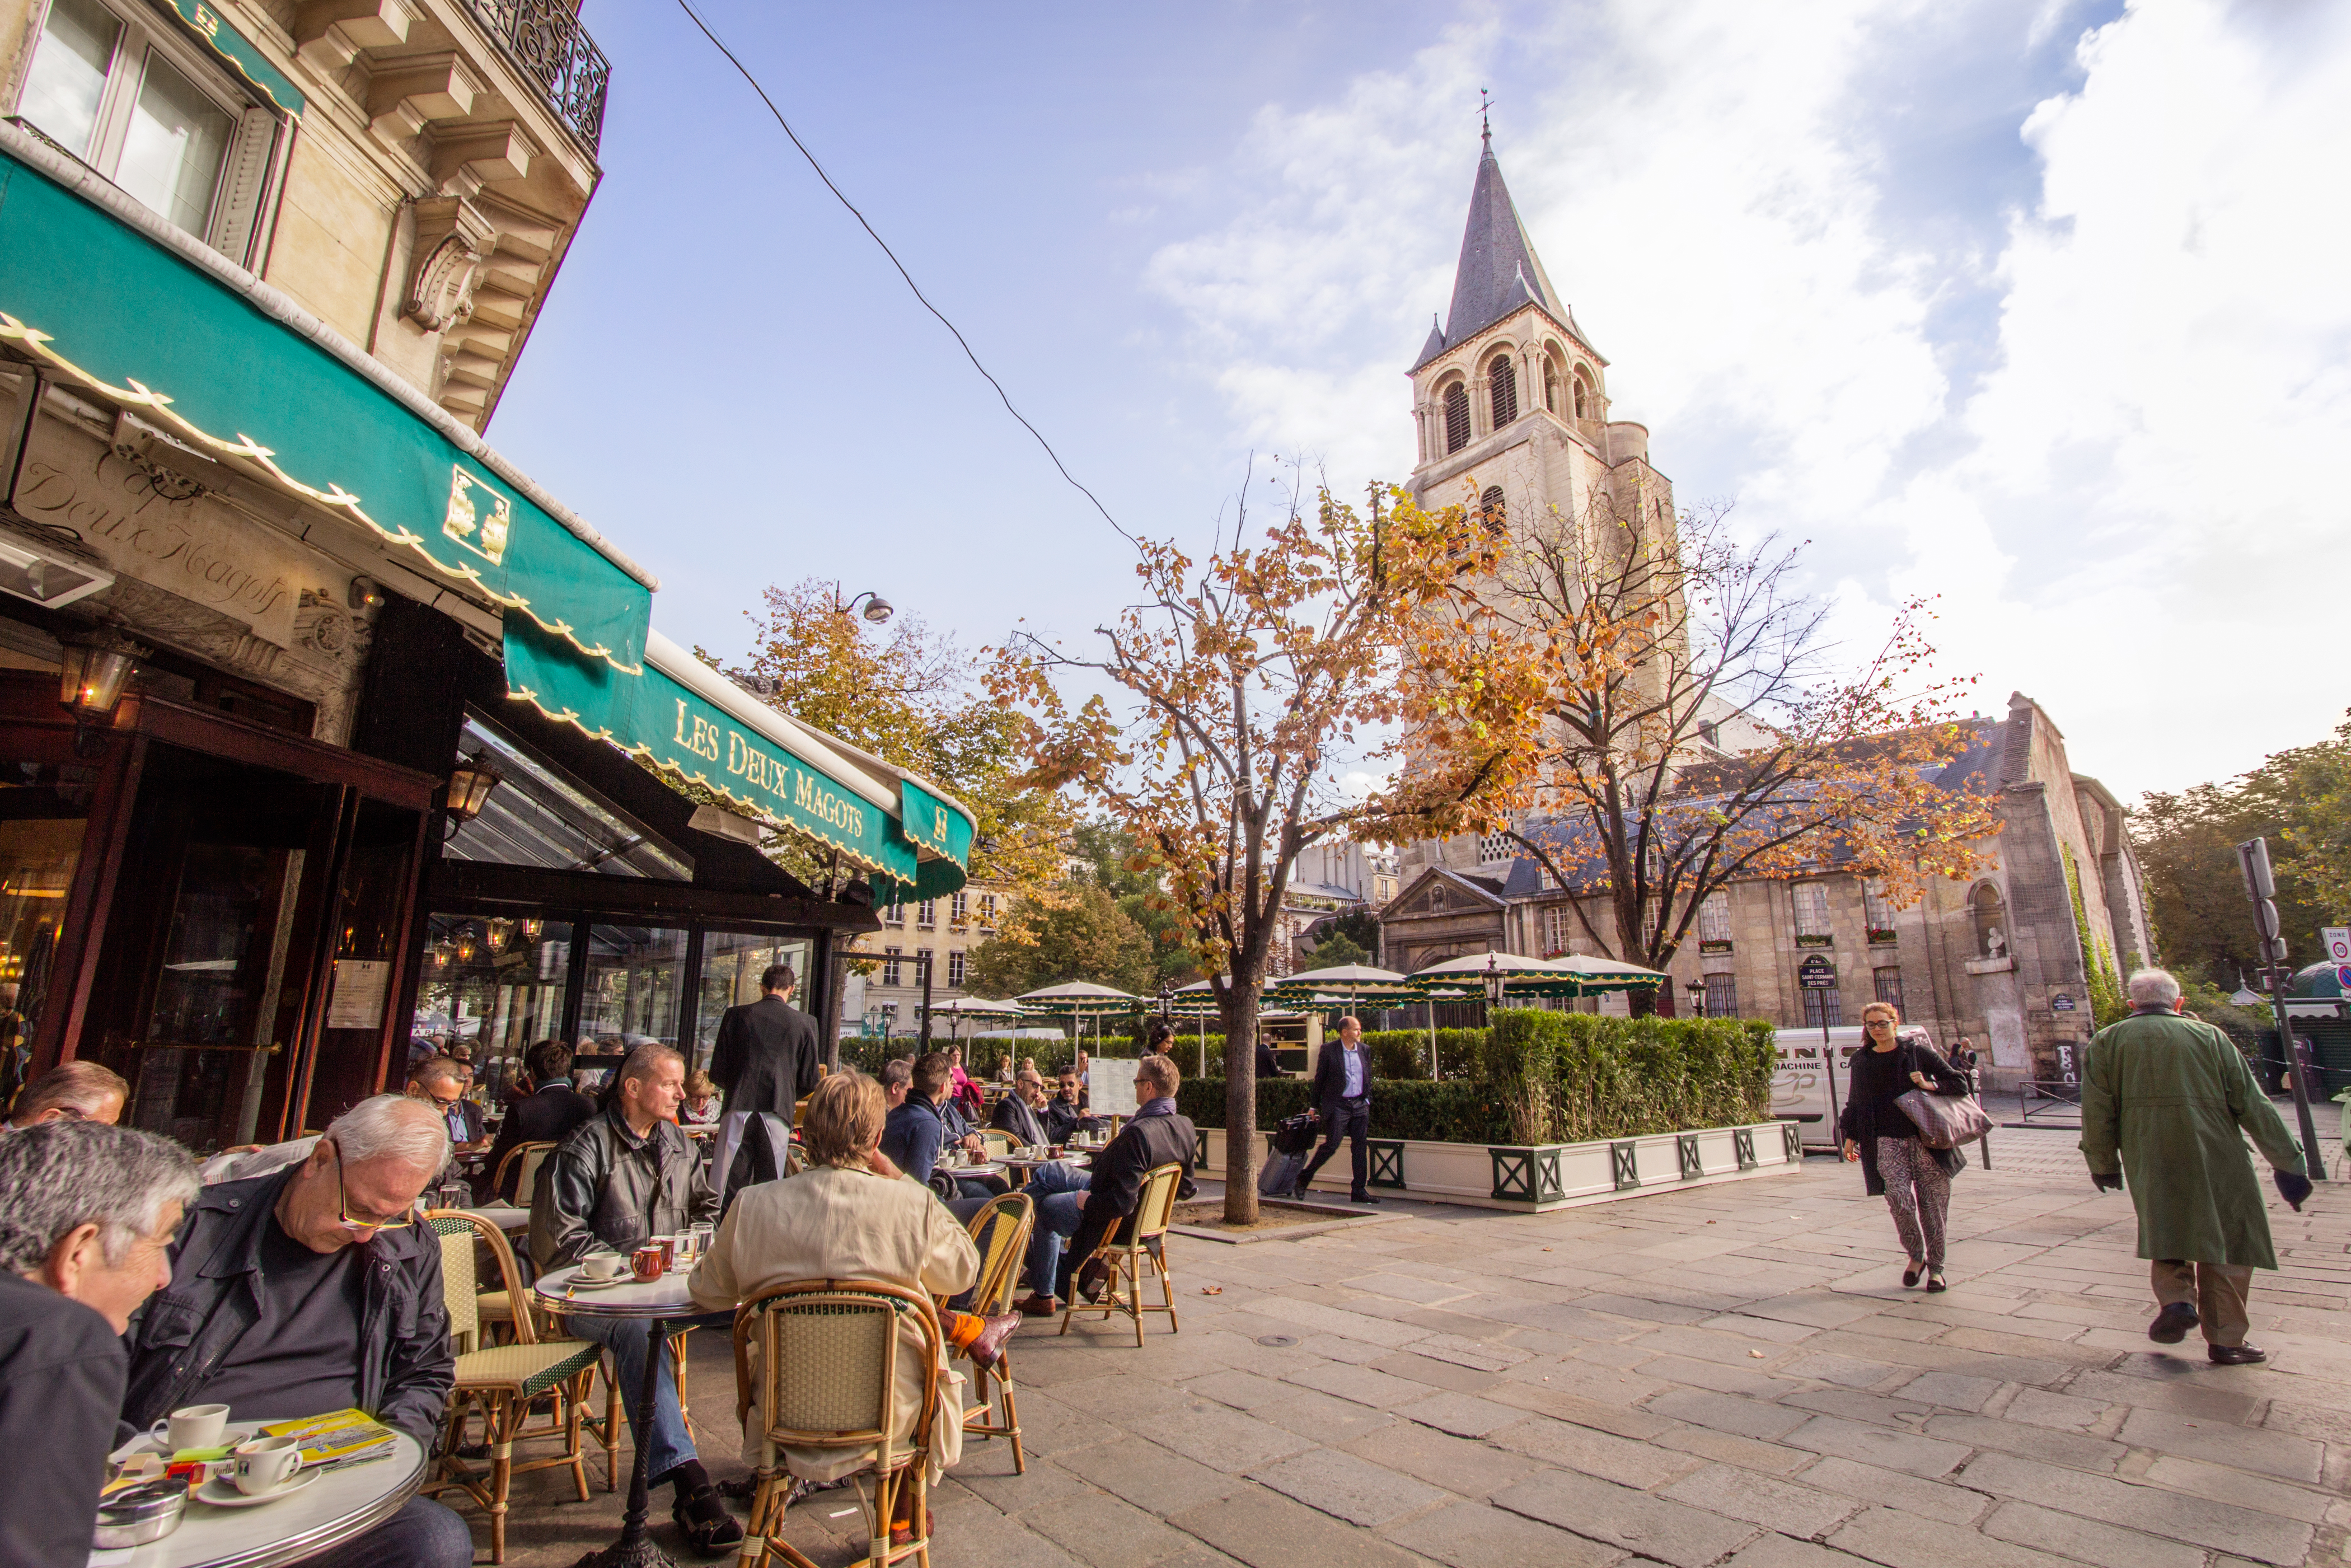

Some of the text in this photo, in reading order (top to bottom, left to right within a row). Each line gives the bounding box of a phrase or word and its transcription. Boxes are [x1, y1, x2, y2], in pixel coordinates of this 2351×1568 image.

[673, 698, 862, 837] LES DEUX MAGOTS
